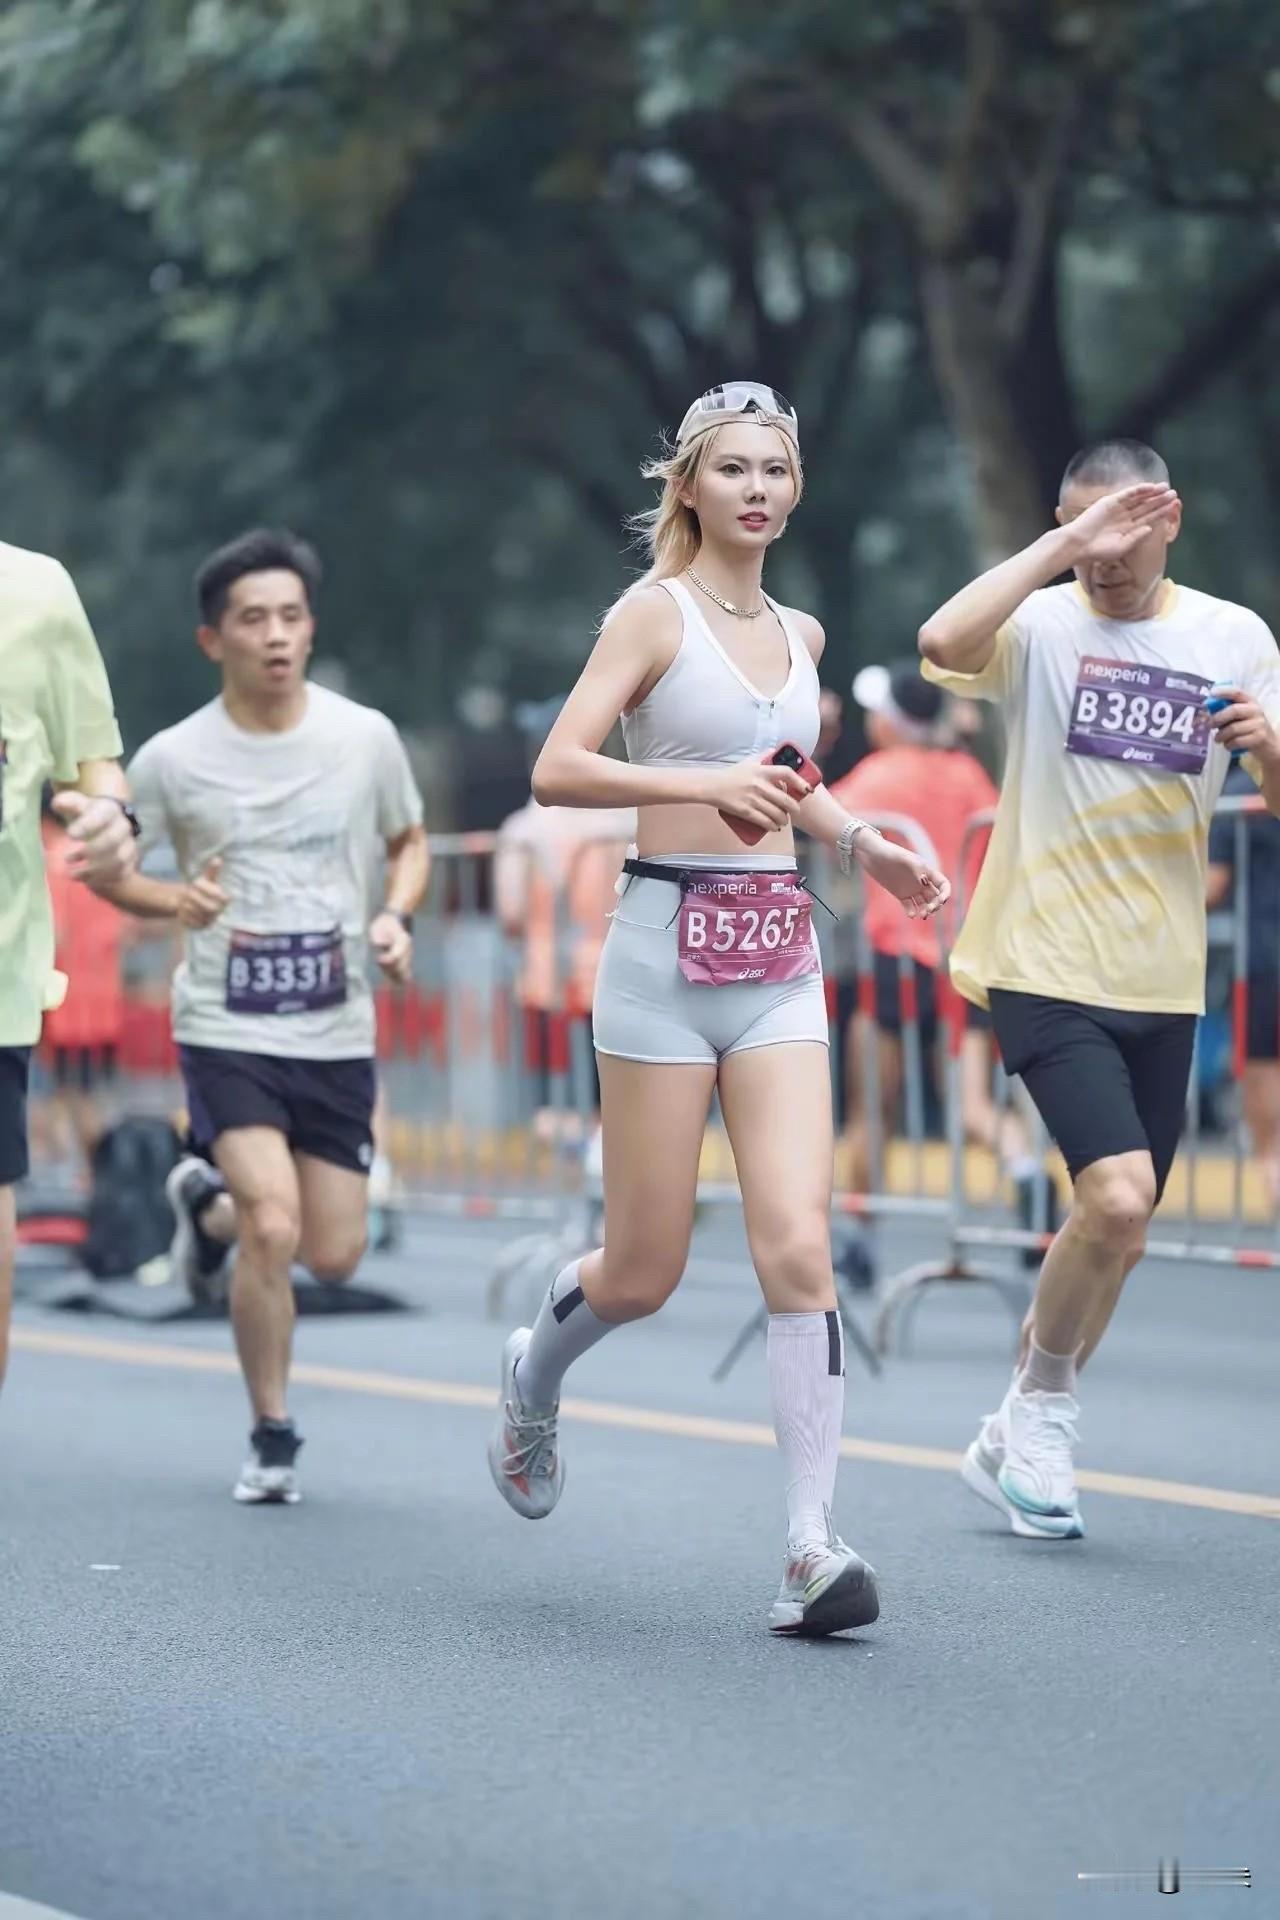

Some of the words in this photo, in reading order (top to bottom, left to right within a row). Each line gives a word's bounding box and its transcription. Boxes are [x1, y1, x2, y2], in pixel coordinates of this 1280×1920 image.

[1084, 662, 1151, 685] nexperia
[1076, 689, 1197, 743] B3894
[687, 880, 757, 899] nexperia
[686, 907, 799, 952] B5265
[230, 952, 332, 993] B3331
